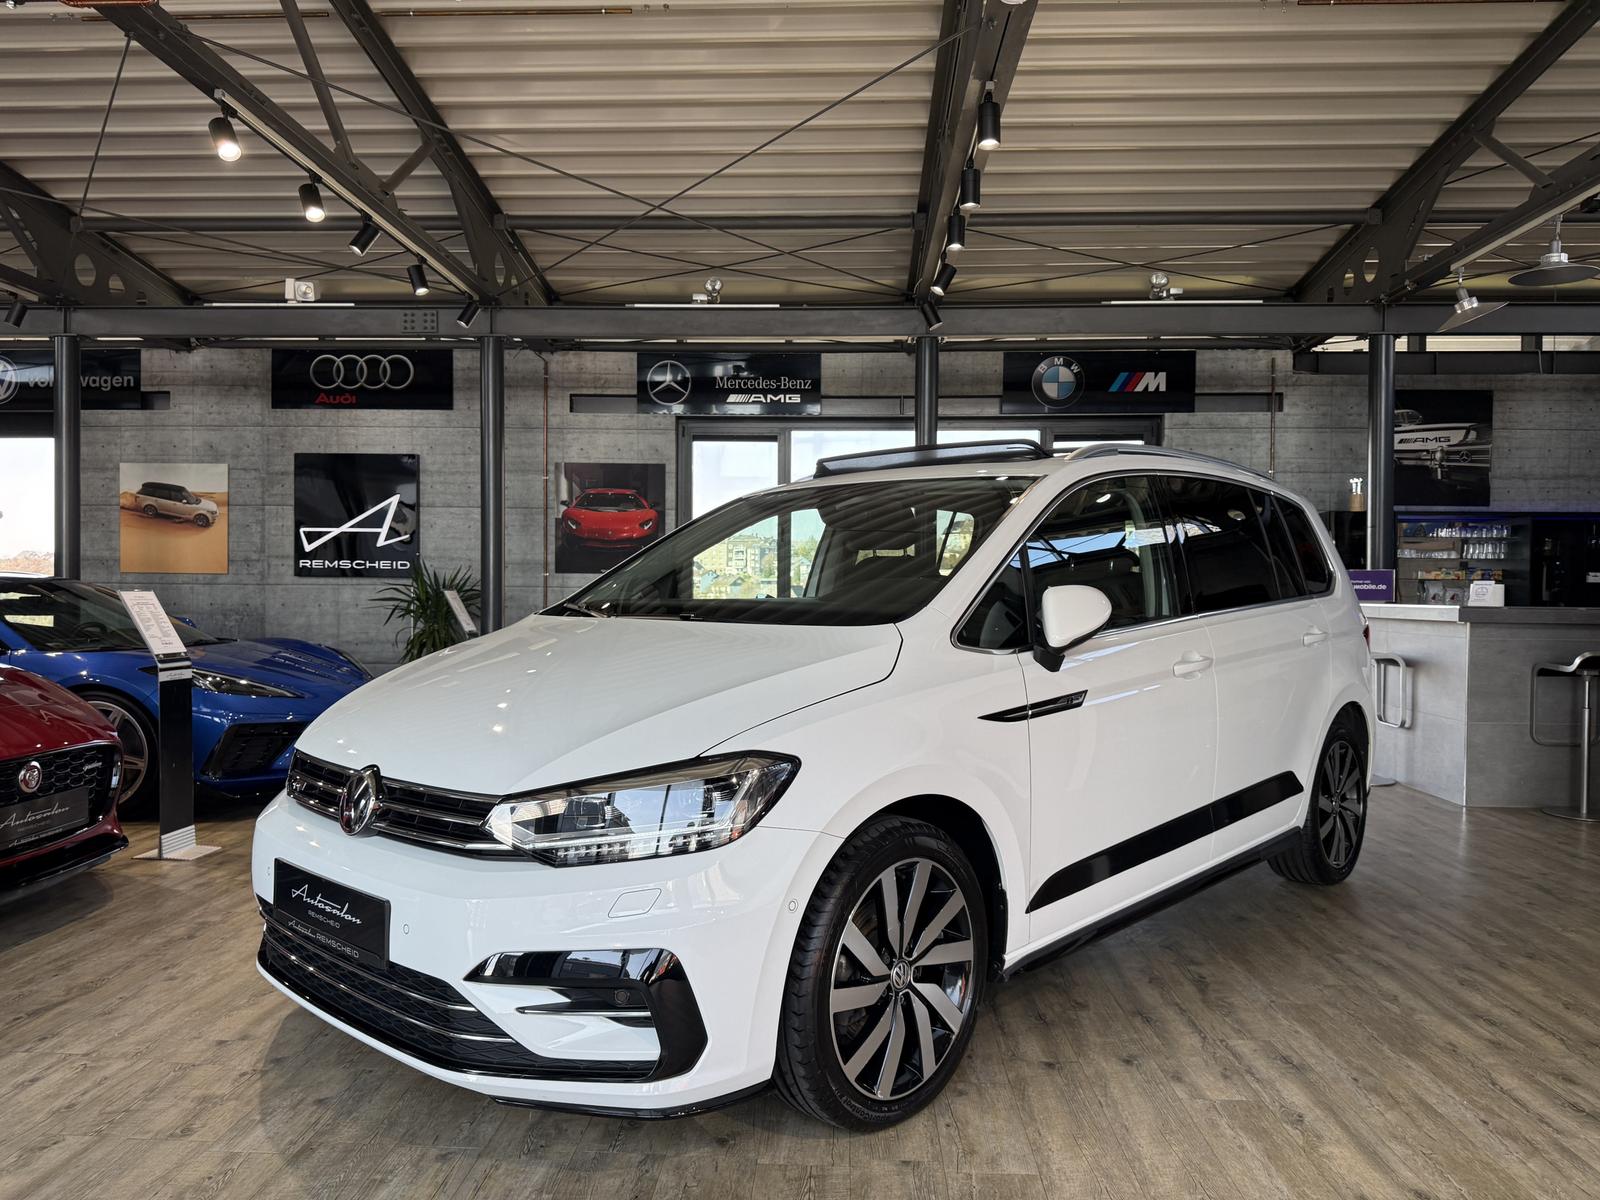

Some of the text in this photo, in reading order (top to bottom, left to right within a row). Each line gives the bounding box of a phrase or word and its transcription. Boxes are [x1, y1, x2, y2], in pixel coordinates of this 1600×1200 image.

[715, 376, 812, 389] Mercedes-Benz
[315, 393, 356, 404] Audi
[749, 394, 801, 403] AMG
[299, 560, 410, 569] REMSCHEID
[291, 884, 362, 924] Autosalon
[308, 909, 341, 929] REMSCHEID
[316, 933, 360, 958] REMSCHEID
